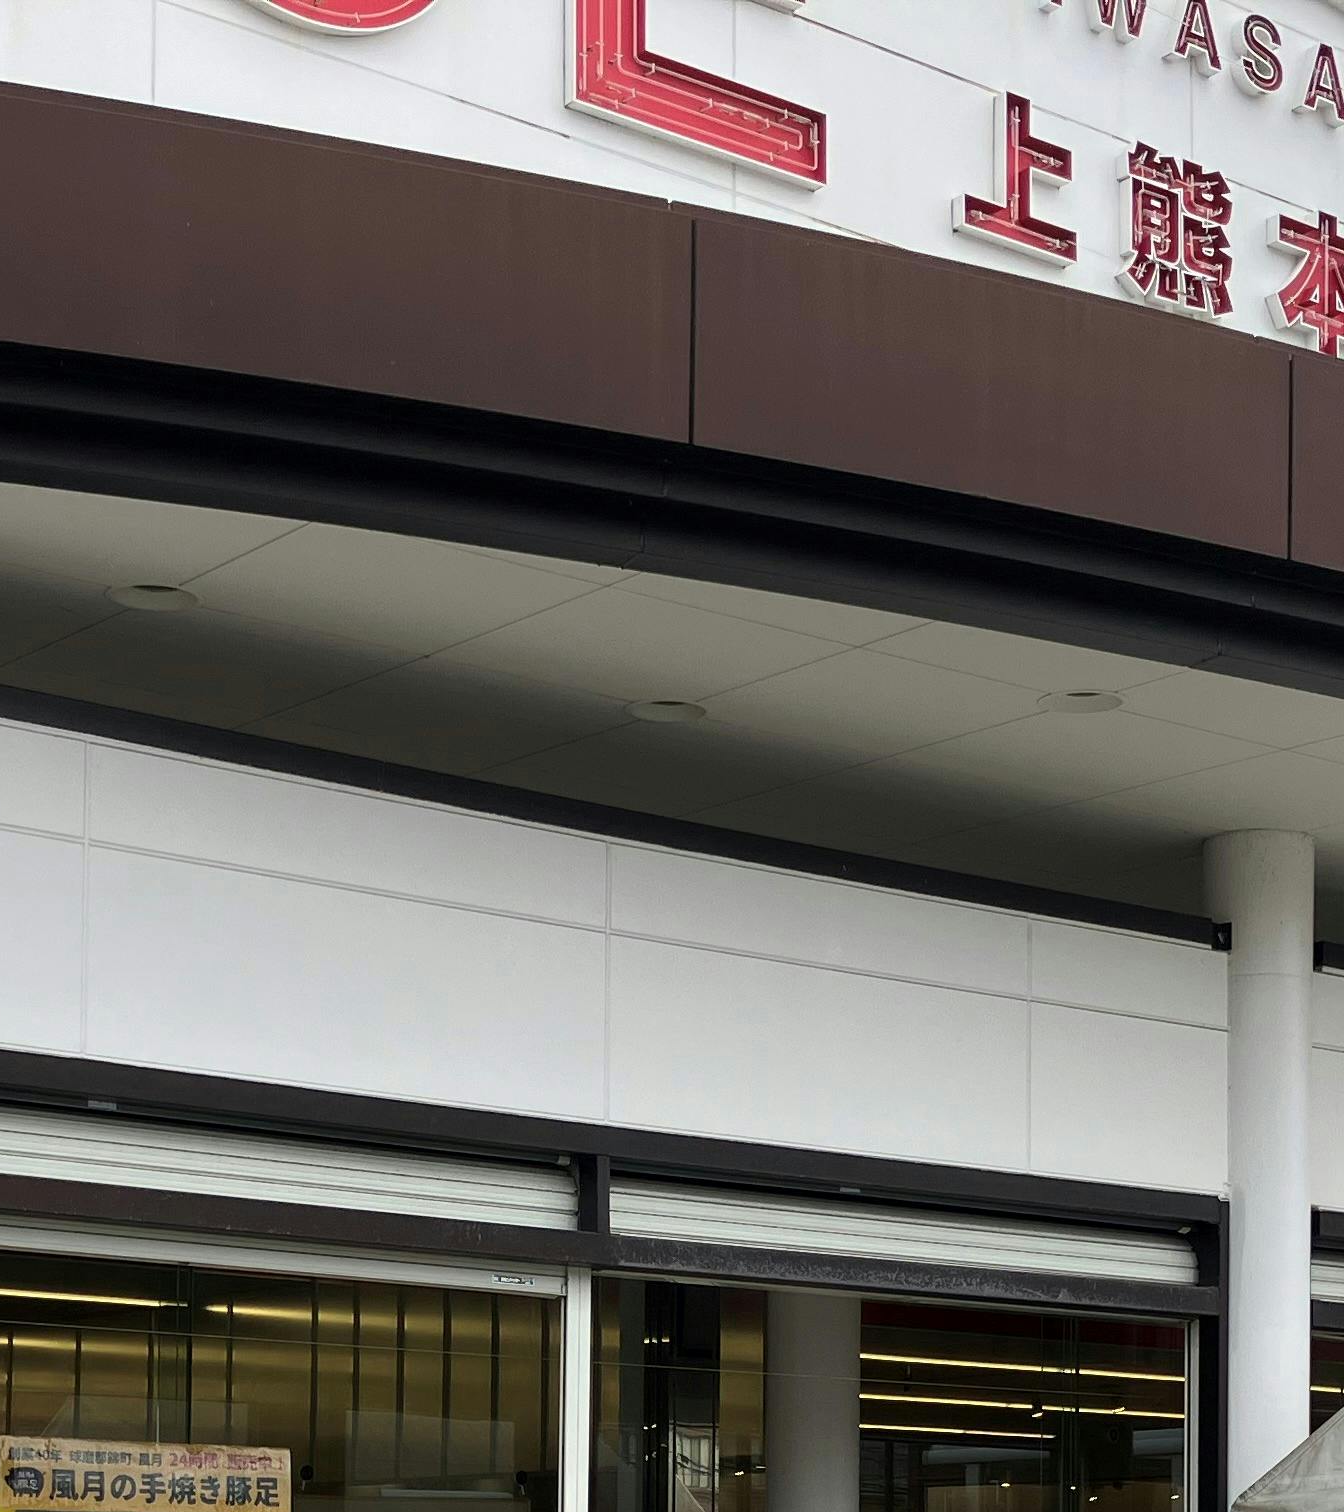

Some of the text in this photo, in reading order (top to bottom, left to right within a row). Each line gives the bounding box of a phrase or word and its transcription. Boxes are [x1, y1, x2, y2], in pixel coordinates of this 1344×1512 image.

[50, 1468, 280, 1508] 風月の手焼き豚足
